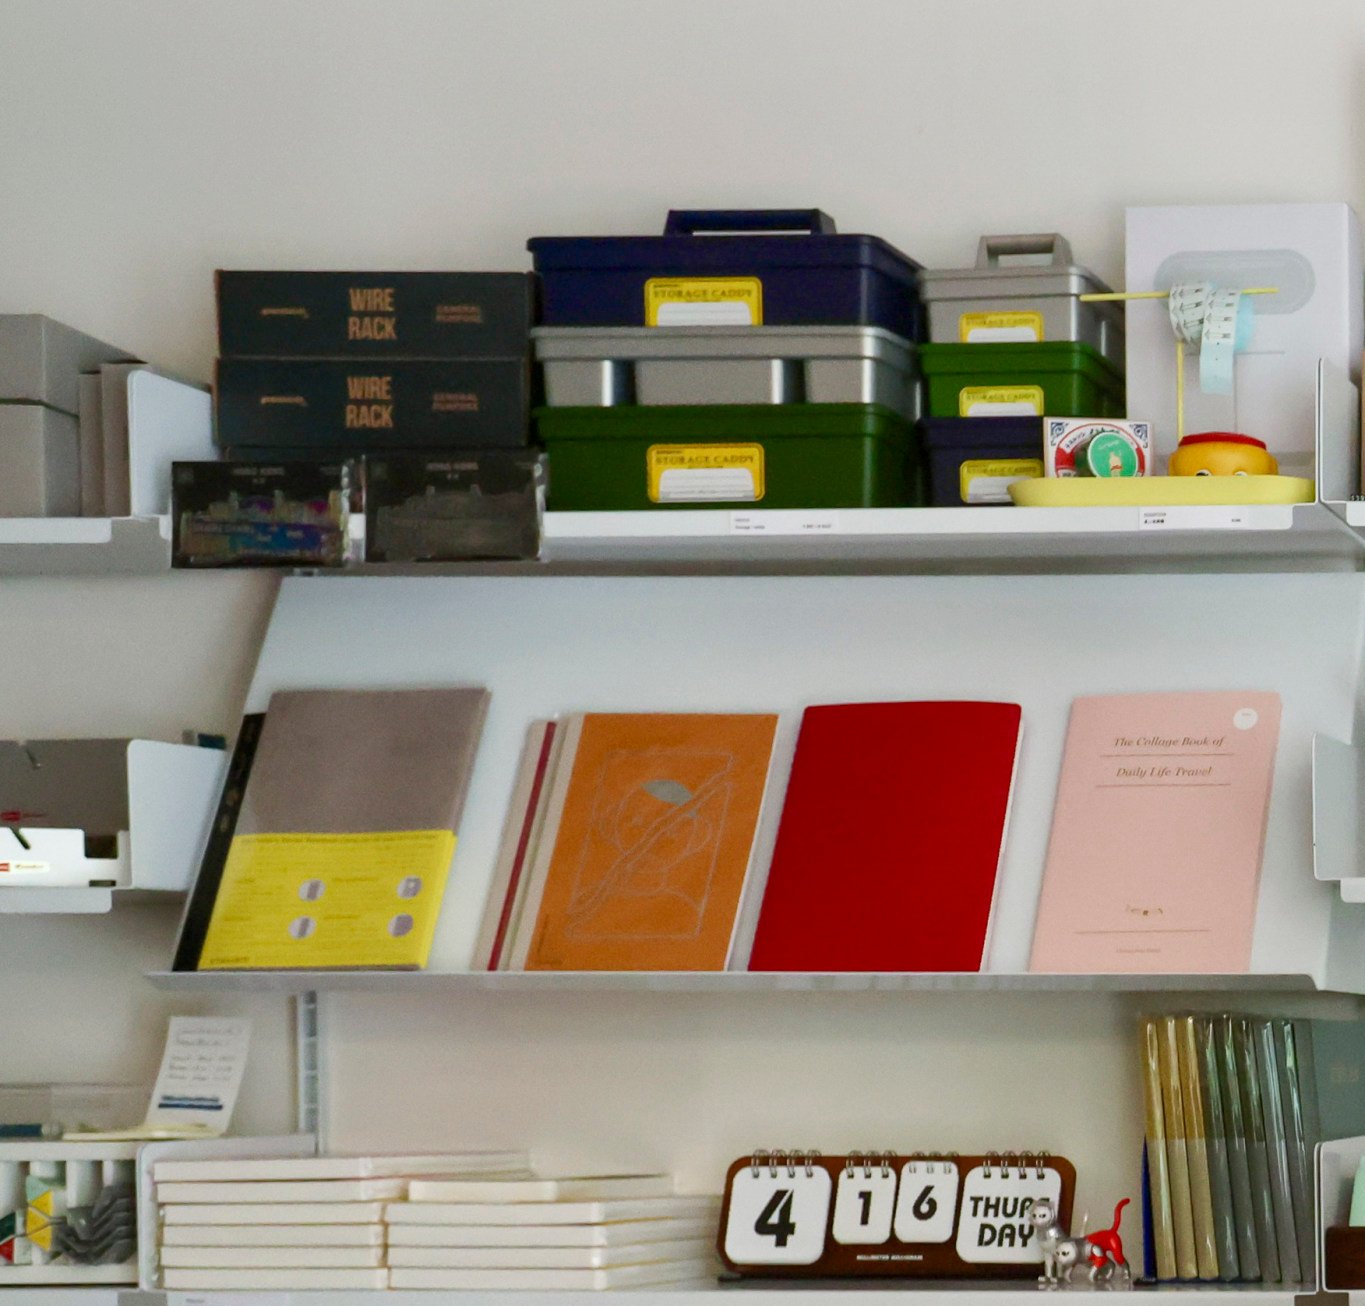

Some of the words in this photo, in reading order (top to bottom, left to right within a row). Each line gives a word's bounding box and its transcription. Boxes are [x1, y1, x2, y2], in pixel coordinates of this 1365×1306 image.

[350, 288, 394, 312] WIRE
[654, 289, 708, 298] STORAGE
[712, 288, 752, 297] CADDY
[348, 317, 397, 340] RACK
[347, 376, 392, 400] WIRE
[346, 405, 394, 428] RACK
[656, 456, 710, 465] STORAGE
[714, 455, 754, 464] CADDY
[1114, 737, 1134, 747] The
[1182, 737, 1208, 746] Book
[1212, 737, 1225, 748] of
[1116, 768, 1147, 779] Daily
[1150, 767, 1172, 778] Life
[1175, 766, 1213, 777] Travel
[857, 1191, 873, 1226] 1
[912, 1185, 938, 1221] 6
[969, 1196, 1050, 1218] THUR
[753, 1188, 797, 1247] 4
[977, 1223, 1035, 1247] DAY
